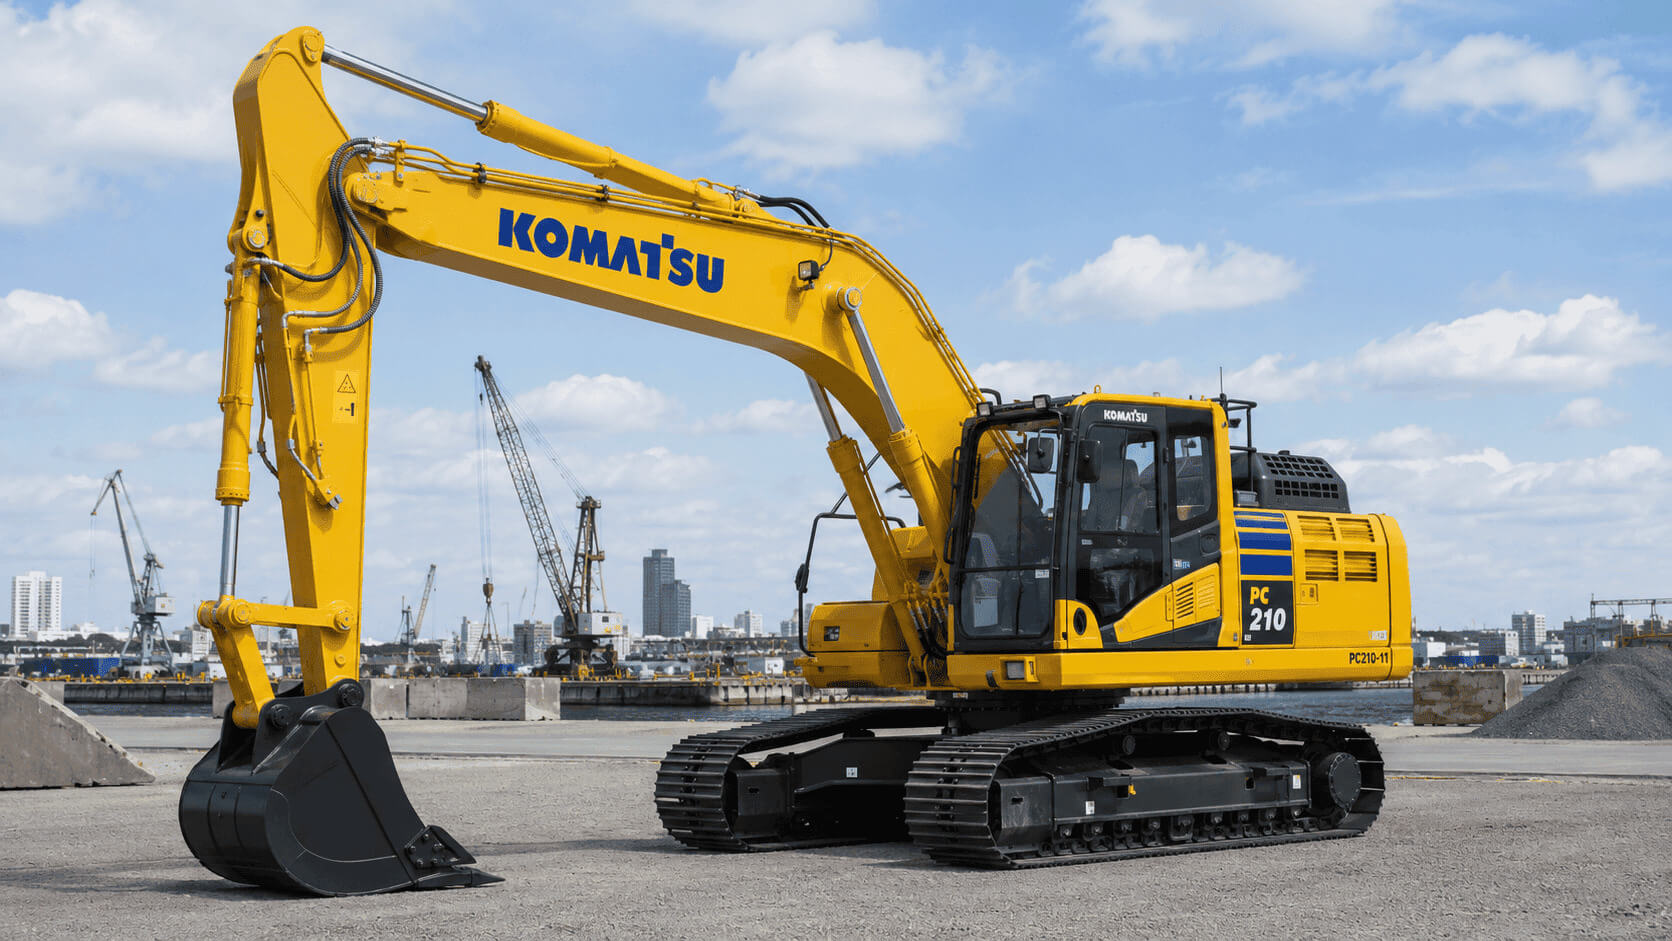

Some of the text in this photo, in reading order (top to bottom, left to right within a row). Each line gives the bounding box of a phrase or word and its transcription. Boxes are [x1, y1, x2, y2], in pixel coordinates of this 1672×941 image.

[498, 208, 724, 293] KOMATSU
[1103, 409, 1148, 423] KOMATSU
[1250, 586, 1269, 605] PC
[1249, 607, 1287, 631] 210
[1349, 652, 1389, 664] PC210-11
